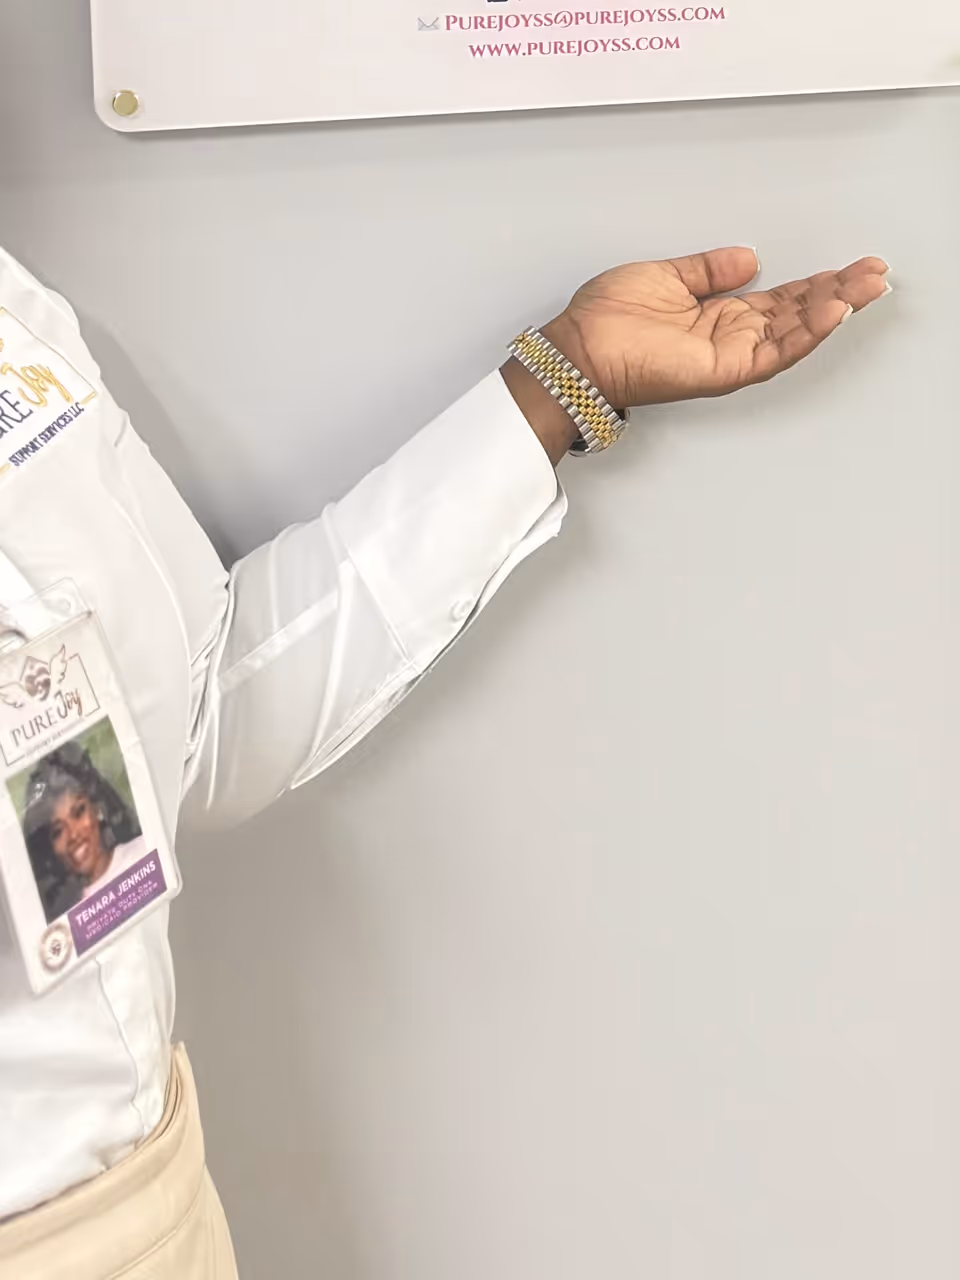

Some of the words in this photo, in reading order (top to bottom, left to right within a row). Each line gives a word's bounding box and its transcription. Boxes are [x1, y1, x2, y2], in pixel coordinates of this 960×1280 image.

[8, 437, 44, 467] SUPPORT
[38, 412, 74, 444] SERVICES
[67, 402, 85, 419] LLC
[11, 707, 58, 747] PURE
[54, 688, 83, 719] Joy
[75, 891, 117, 926] TENARA
[117, 860, 156, 896] JENKINS
